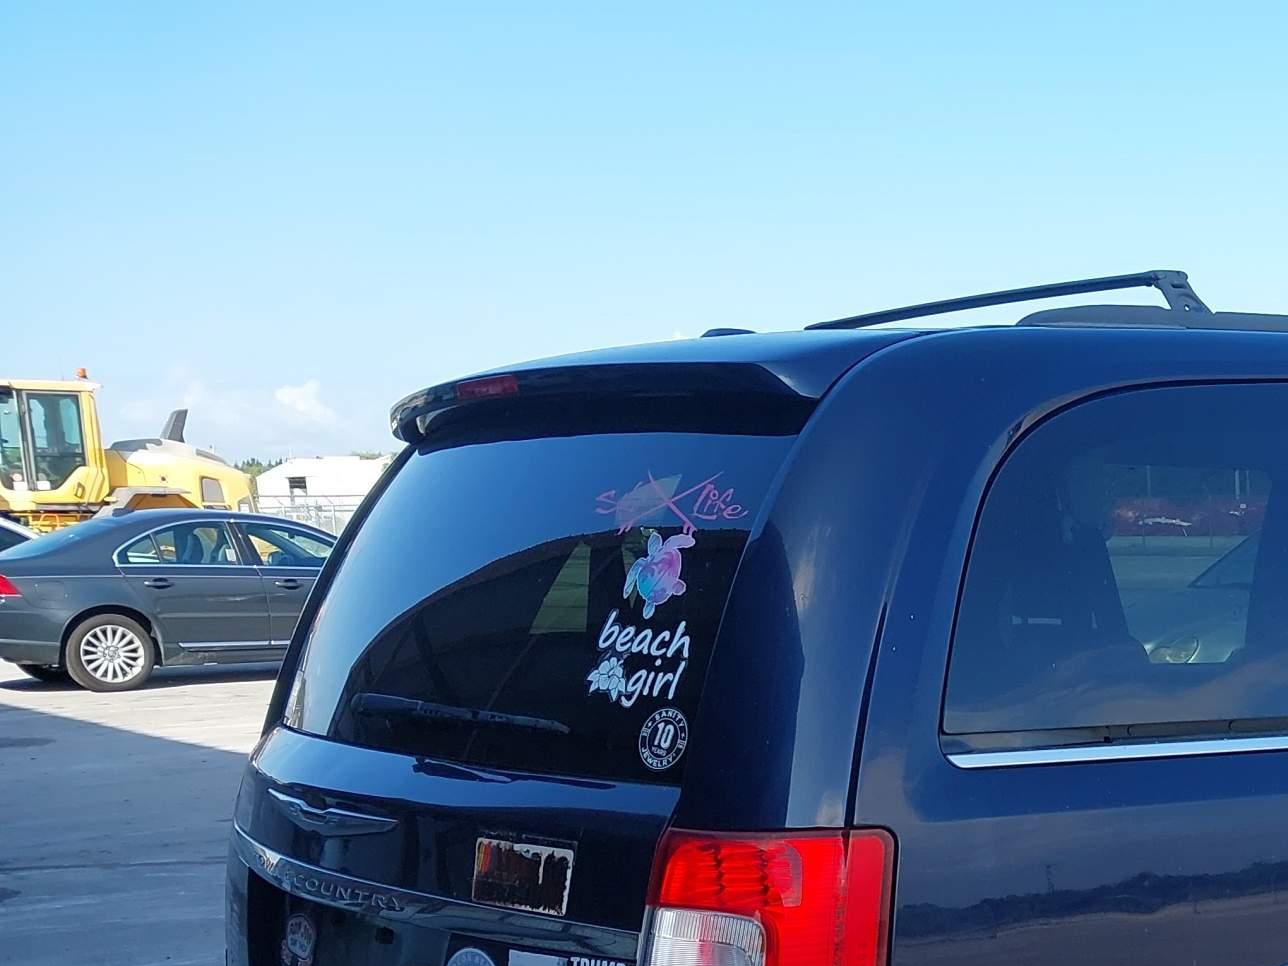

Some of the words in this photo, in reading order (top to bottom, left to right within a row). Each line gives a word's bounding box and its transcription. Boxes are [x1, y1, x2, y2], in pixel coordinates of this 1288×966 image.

[694, 484, 748, 519] Life
[598, 610, 690, 658] beach
[621, 658, 686, 707] girl
[653, 721, 675, 750] 10
[655, 710, 685, 727] SANITY
[641, 747, 674, 768] JEWELRY
[294, 873, 401, 911] COUNTRY
